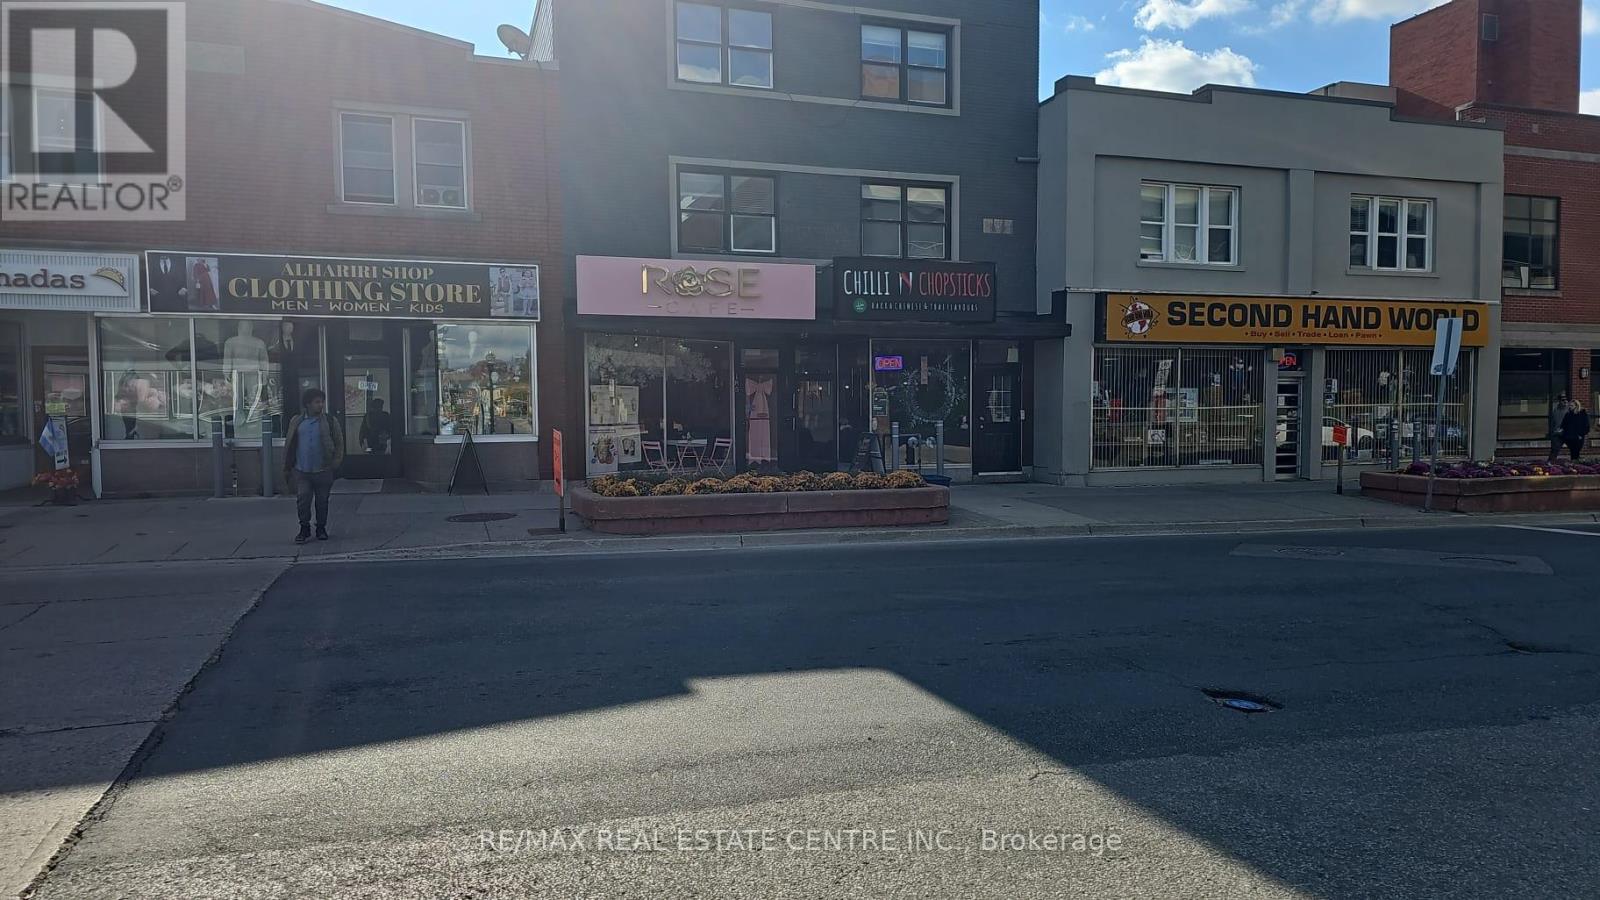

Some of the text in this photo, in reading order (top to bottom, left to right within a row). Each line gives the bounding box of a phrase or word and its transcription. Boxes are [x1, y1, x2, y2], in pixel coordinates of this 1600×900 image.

[282, 263, 434, 280] ALHARIRI SHOP
[641, 264, 761, 299] ROSE
[843, 270, 991, 297] CHILLI N CHOPSTICKS
[228, 277, 482, 304] CLOTHING STORE
[271, 300, 309, 311] MEN
[329, 301, 390, 312] WOMEN
[409, 303, 444, 314] KIDS
[665, 301, 738, 316] CAFE
[1167, 301, 1293, 328] SECOND
[1302, 305, 1382, 330] HAND
[1251, 330, 1267, 338] Buy
[1274, 330, 1291, 338] Sell
[1297, 331, 1322, 339] Trade
[1328, 332, 1349, 340] Loan
[879, 358, 901, 368] OPEN
